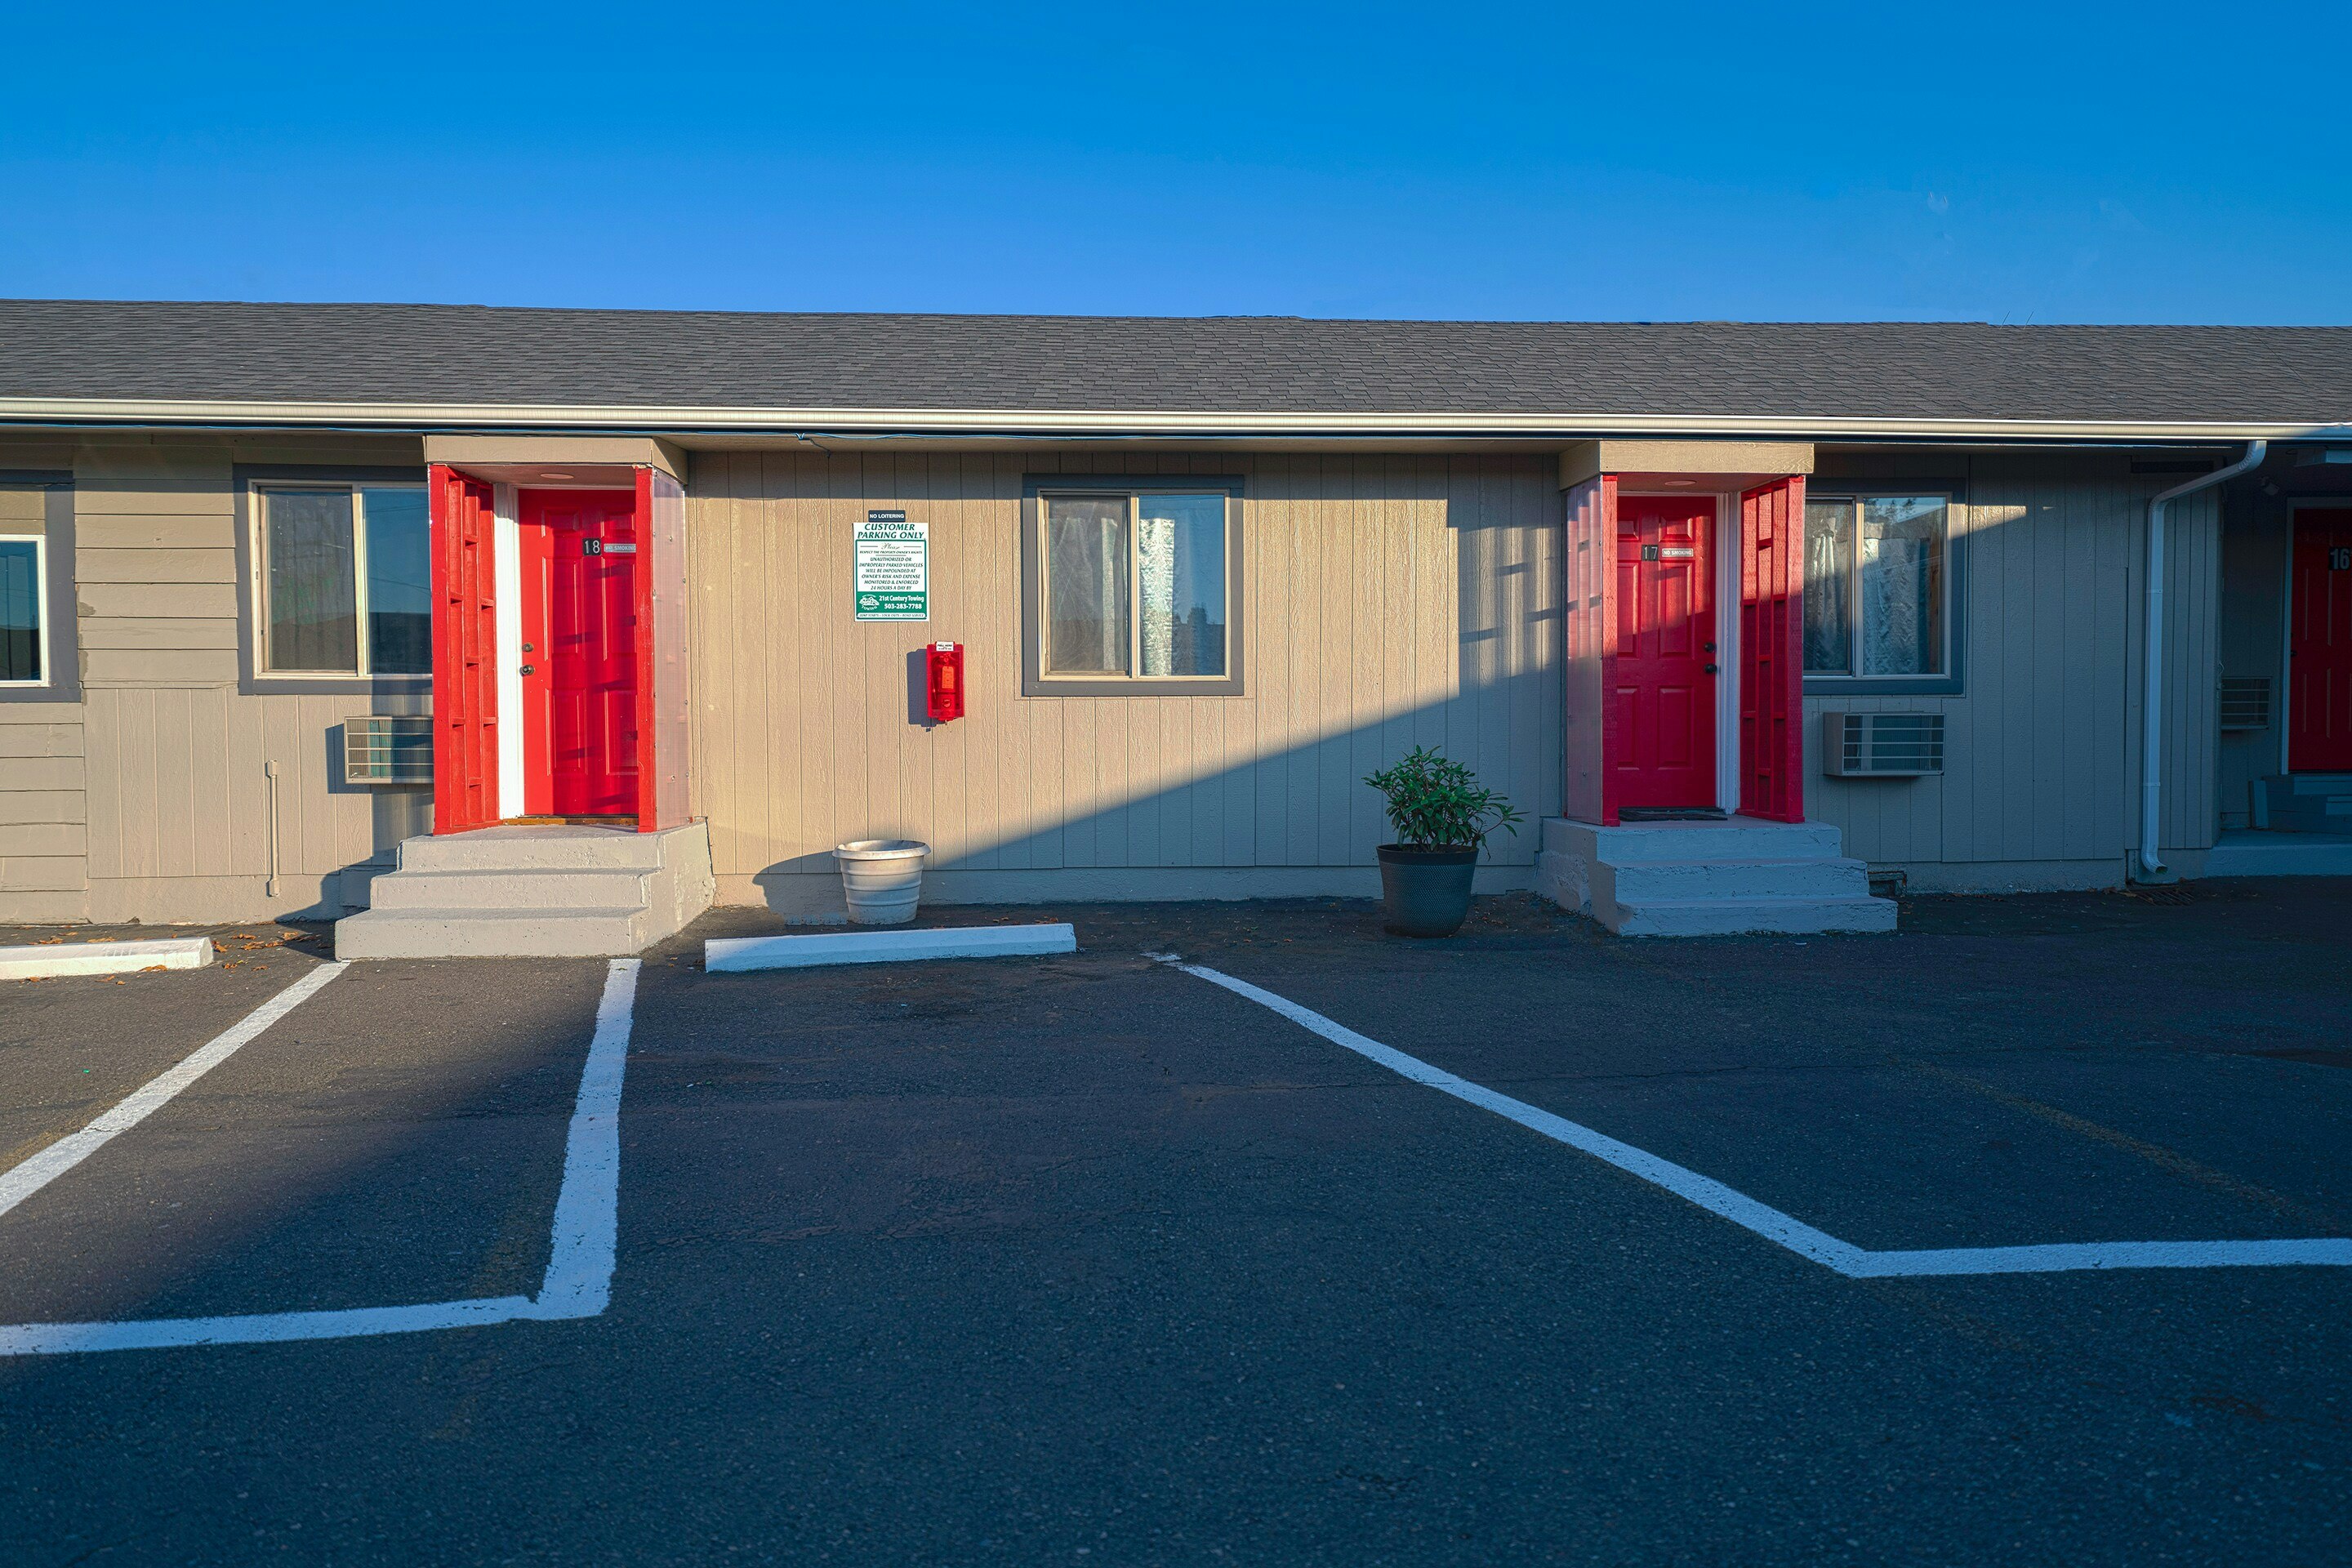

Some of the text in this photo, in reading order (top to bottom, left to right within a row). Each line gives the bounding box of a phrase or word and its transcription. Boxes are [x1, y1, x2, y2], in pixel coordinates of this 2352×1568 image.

[585, 540, 600, 553] 18
[1645, 546, 1657, 559] 17
[2330, 548, 2350, 569] 16
